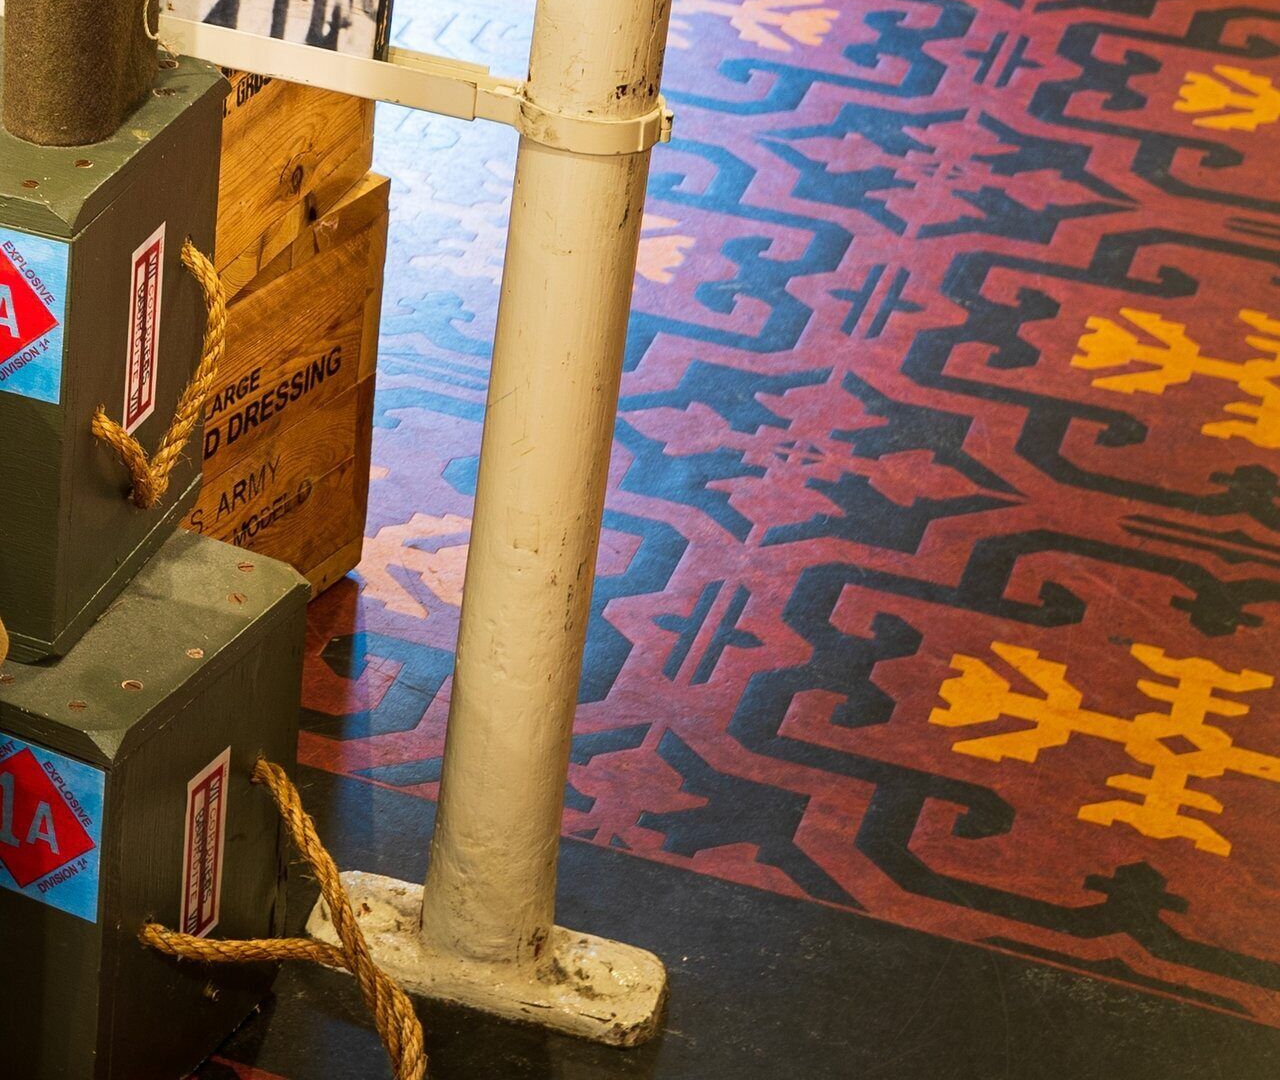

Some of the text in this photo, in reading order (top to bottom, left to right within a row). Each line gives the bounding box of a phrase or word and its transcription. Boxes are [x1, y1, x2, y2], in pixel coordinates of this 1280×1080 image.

[2, 240, 56, 306] EXPLOSIVE
[226, 346, 342, 445] DRESSING
[216, 454, 280, 522] ARMY
[42, 760, 93, 828] EXPLOSIVE
[37, 861, 78, 895] DIVISION
